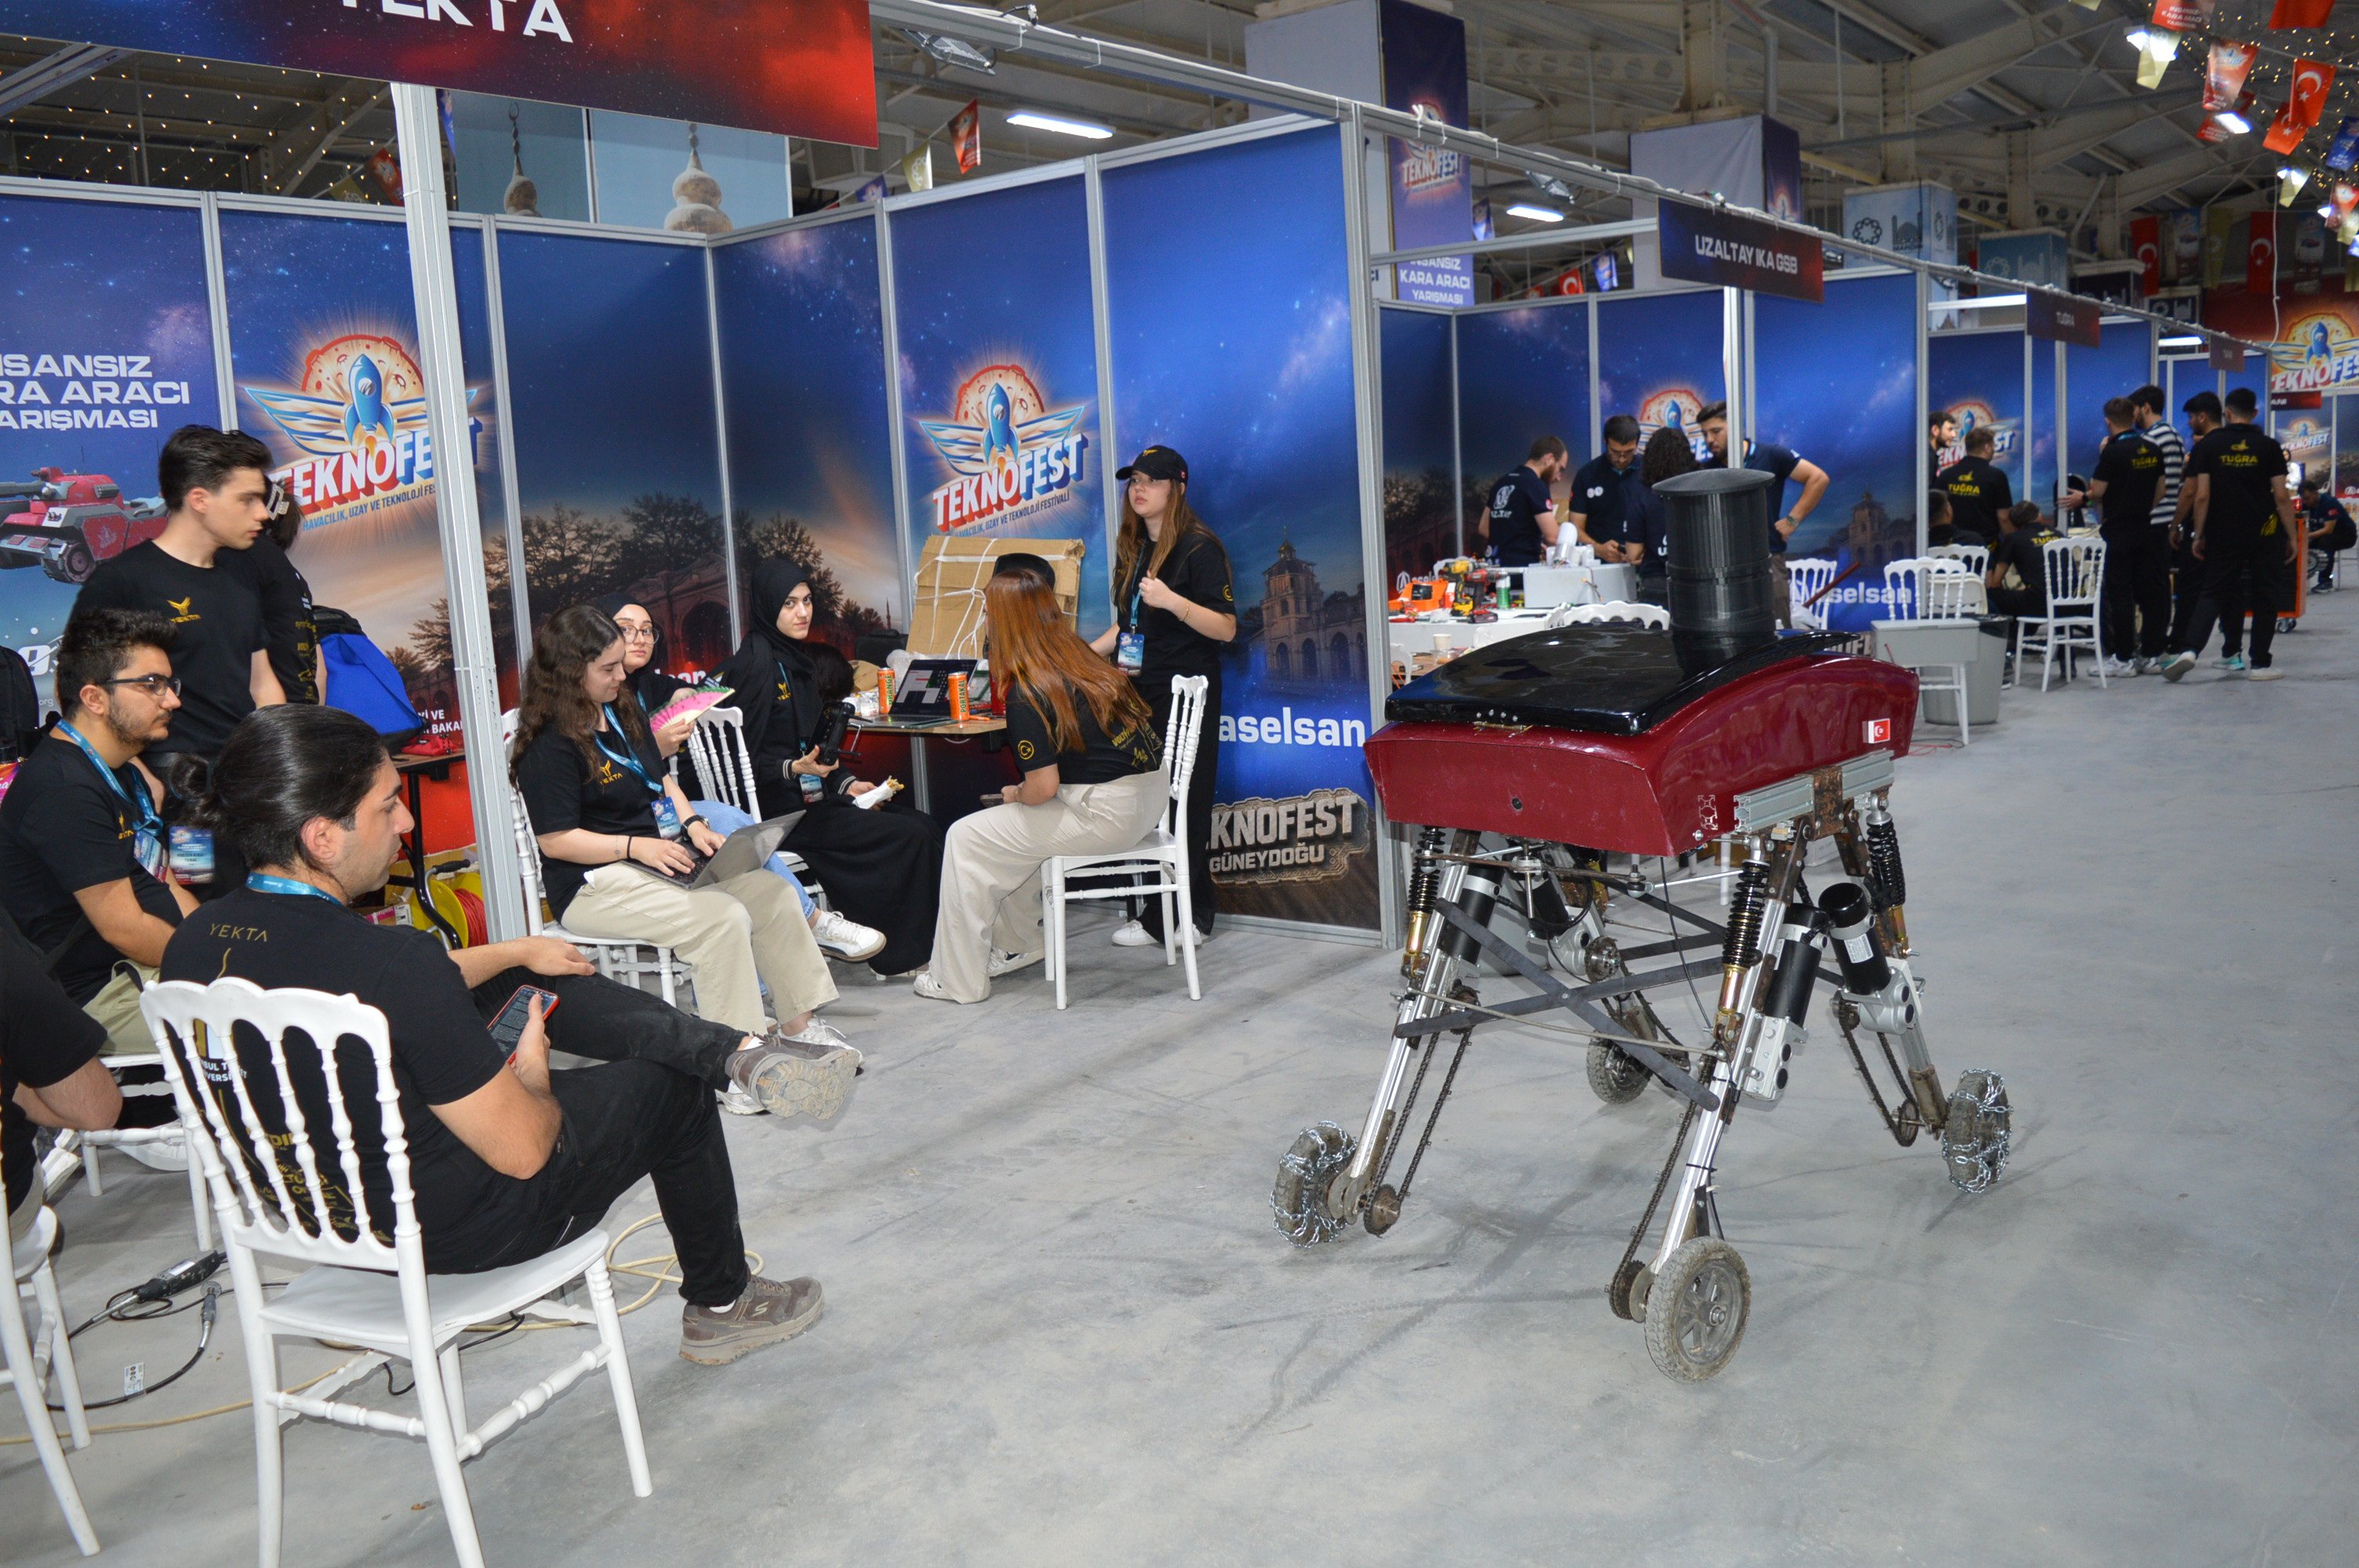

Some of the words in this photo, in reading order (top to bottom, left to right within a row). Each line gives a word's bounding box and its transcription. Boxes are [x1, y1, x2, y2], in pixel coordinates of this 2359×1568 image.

[1695, 234, 1754, 265] UZALTAY
[1776, 252, 1798, 274] GSB
[1400, 270, 1434, 285] KARA
[1436, 273, 1470, 289] ARACI
[1412, 289, 1463, 304] YARIŞMASI
[0, 354, 153, 377] SANSIZ
[60, 381, 190, 405] ARACI
[2220, 453, 2259, 463] TUĞRA
[932, 433, 1089, 533] TEKNOFEST
[1948, 483, 1981, 495] TUĞRA
[348, 503, 369, 518] UZAY
[369, 499, 381, 512] VE
[381, 485, 423, 509] TEKNOLOJİ
[985, 517, 1000, 531] UZAY
[1000, 516, 1009, 524] VE
[1009, 500, 1040, 521] TEKNOLOJİ
[958, 679, 967, 713] PORTAKAL
[431, 710, 445, 720] VE
[1219, 706, 1366, 747] aselsan
[431, 720, 463, 735] BAKA
[1205, 795, 1358, 850] KNOFEST
[1209, 842, 1325, 873] GÜNEYDOĞU
[209, 923, 268, 942] YEKTA
